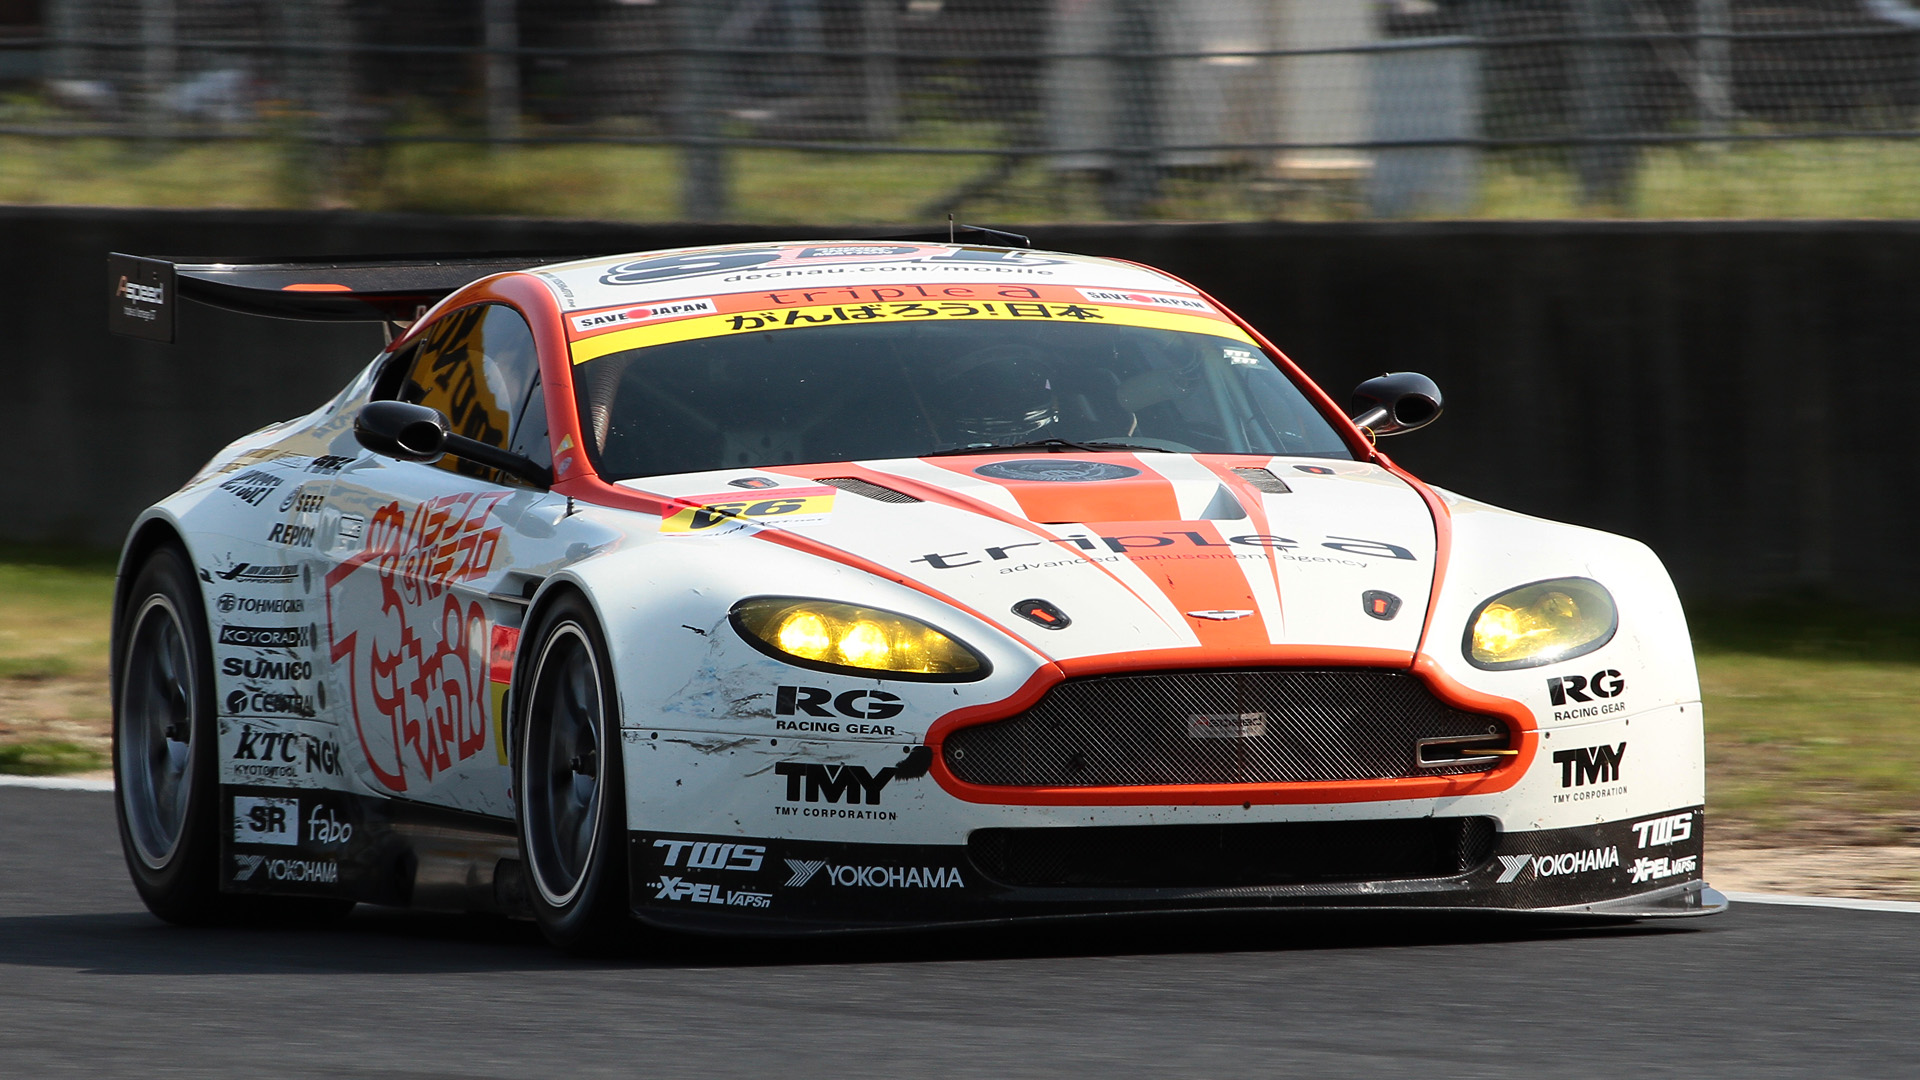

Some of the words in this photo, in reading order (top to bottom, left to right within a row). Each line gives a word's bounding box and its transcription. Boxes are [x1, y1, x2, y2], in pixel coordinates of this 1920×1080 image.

[723, 264, 1054, 282] dechau.com/mobile
[764, 284, 983, 305] triple
[1088, 290, 1132, 302] SAVE
[1151, 296, 1206, 309] JAPAN
[581, 311, 630, 327] SAVE
[650, 303, 708, 316] JAPAN
[689, 499, 807, 529] 66
[910, 531, 1299, 569] triple
[1321, 536, 1417, 561] a
[1000, 555, 1119, 574] advanced
[1130, 553, 1270, 562] amusement
[1283, 555, 1367, 568] agency
[223, 630, 297, 643] KOYORAD
[222, 658, 312, 680] SUMICO
[1547, 669, 1625, 706] RG
[251, 693, 314, 714] CETRAL
[776, 686, 905, 719] RG
[1554, 706, 1599, 721] RACING
[1601, 702, 1626, 715] GEAR
[776, 721, 840, 733] RACING
[846, 724, 895, 735] GEAR
[233, 731, 298, 762] KTC
[305, 737, 344, 776] NGK
[1553, 742, 1627, 788] TMY
[775, 762, 899, 805] TMY
[1553, 793, 1570, 804] TMY
[1573, 786, 1628, 802] CORPORATION
[250, 806, 286, 833] SR
[308, 804, 353, 844] fabo
[775, 807, 798, 815] TMY
[803, 808, 897, 820] CORPORATION
[1632, 812, 1693, 849] TWS
[653, 839, 766, 872] TWS
[1532, 846, 1620, 877] YOKOHAMA
[266, 859, 338, 883] YOKOHAMA
[826, 864, 965, 888] YOKOHAMA
[1632, 857, 1673, 884] XPEL
[653, 875, 725, 905] XPEL
